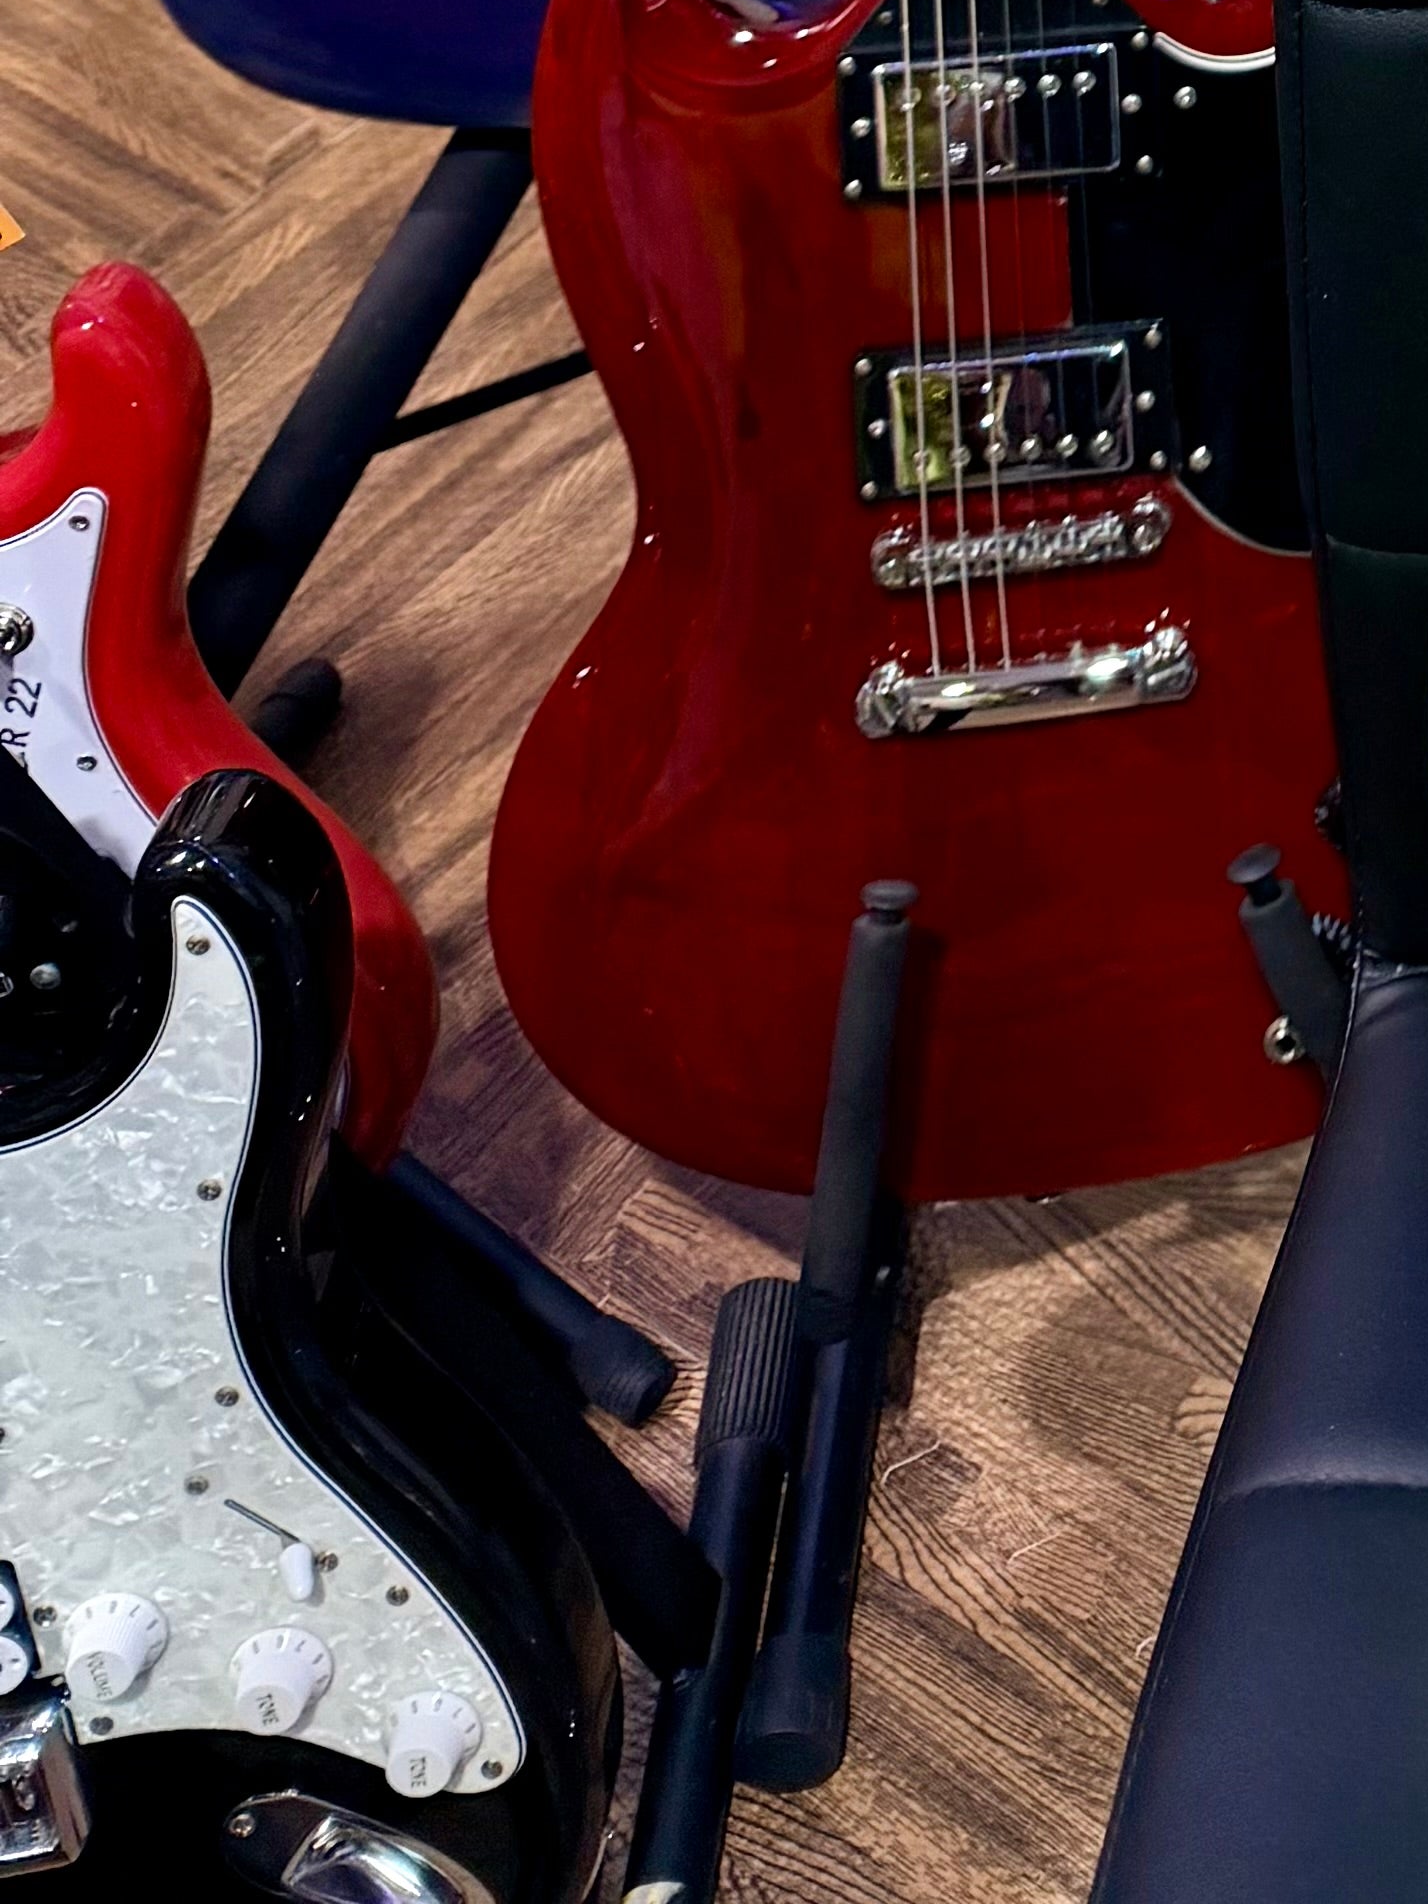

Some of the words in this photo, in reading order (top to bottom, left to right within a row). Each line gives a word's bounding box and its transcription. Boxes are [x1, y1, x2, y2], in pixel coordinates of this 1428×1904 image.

[4, 678, 41, 718] 22
[87, 1651, 113, 1698] VOLUME
[255, 1693, 279, 1726] TONE
[408, 1756, 427, 1788] TONE
